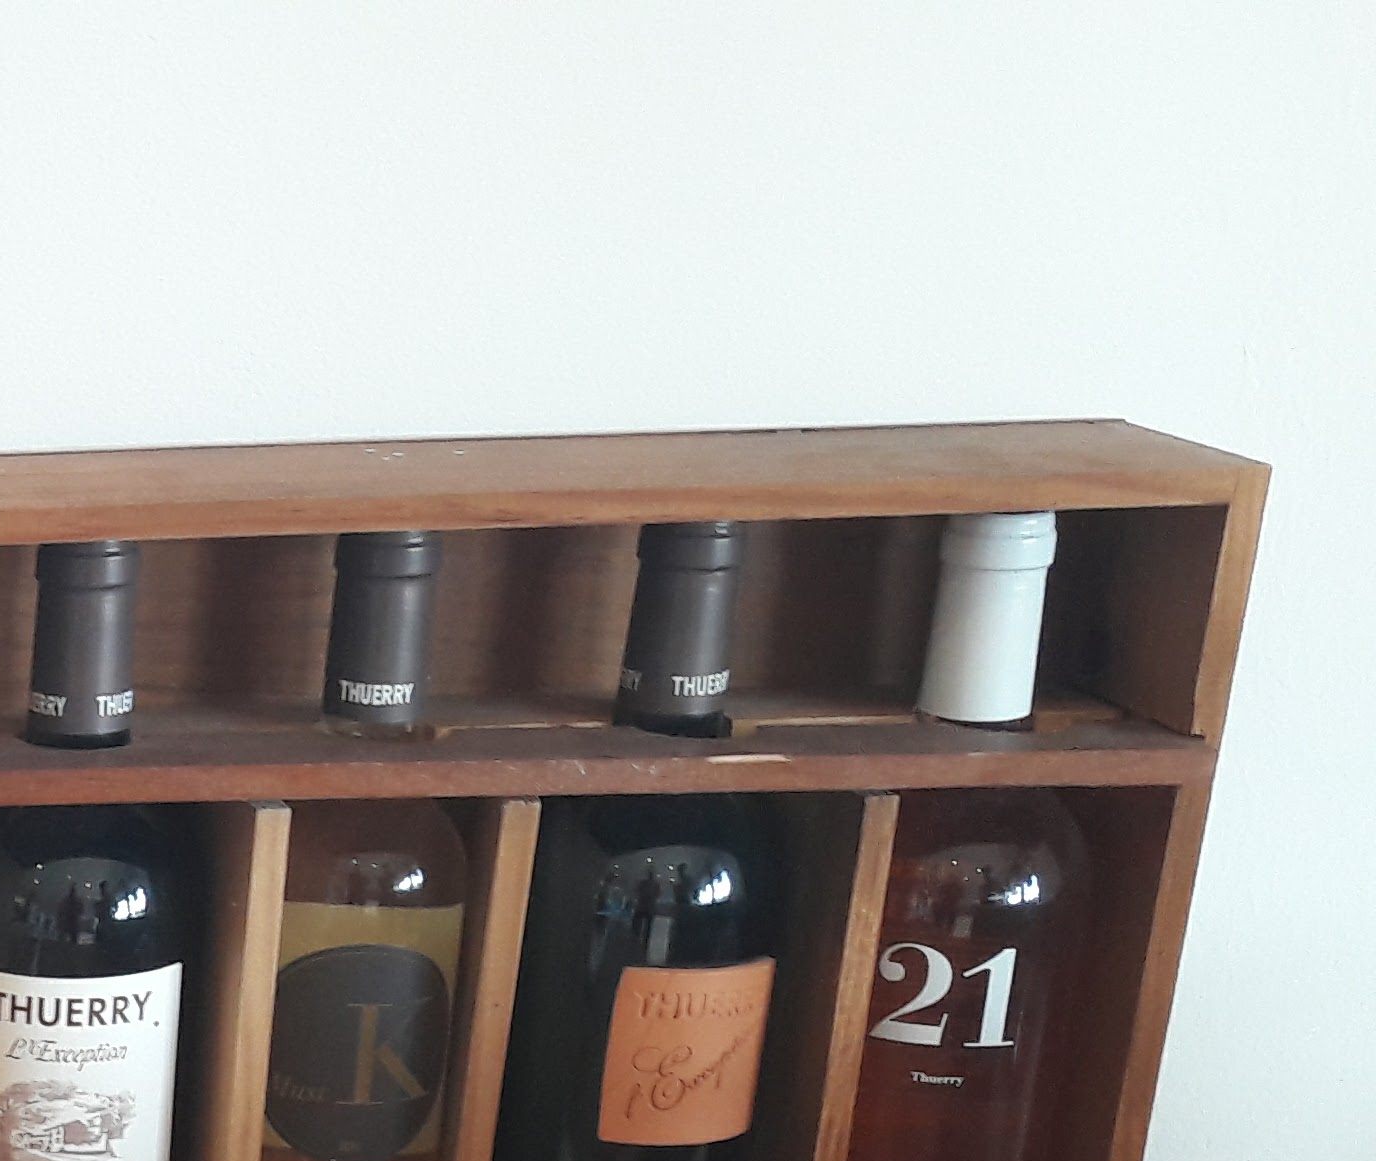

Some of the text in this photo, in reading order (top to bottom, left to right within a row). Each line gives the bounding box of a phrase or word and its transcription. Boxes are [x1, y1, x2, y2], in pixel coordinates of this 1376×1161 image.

[338, 680, 415, 705] THUERRY
[869, 942, 1017, 1048] 21
[911, 1071, 965, 1087] Thuerry
